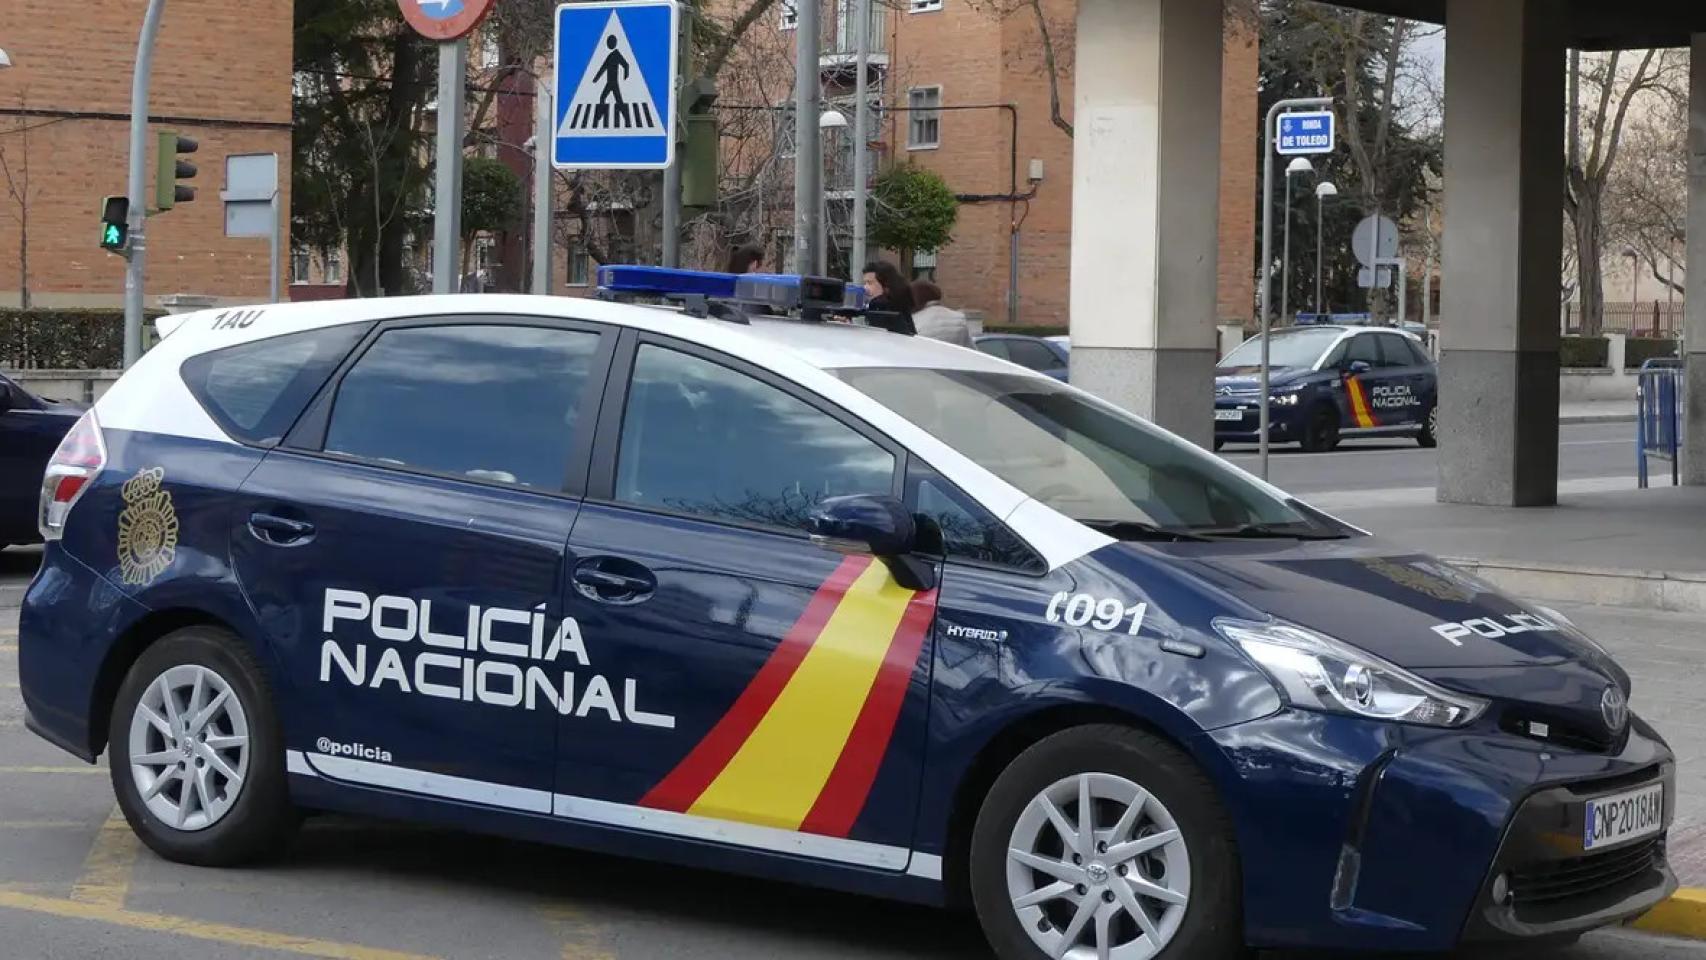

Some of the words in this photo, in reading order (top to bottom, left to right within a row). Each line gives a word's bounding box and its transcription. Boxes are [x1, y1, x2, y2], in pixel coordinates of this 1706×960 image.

[1302, 119, 1322, 130] RONDA
[1282, 135, 1295, 147] DE
[1295, 134, 1328, 147] TOLEDO
[211, 310, 264, 330] 1AU
[1372, 395, 1421, 408] NACIONAL
[1064, 593, 1147, 635] 091
[323, 588, 591, 665] POLICÍA
[947, 625, 998, 640] HYBRID
[320, 639, 676, 728] NACIONAL
[317, 736, 392, 762] @policia
